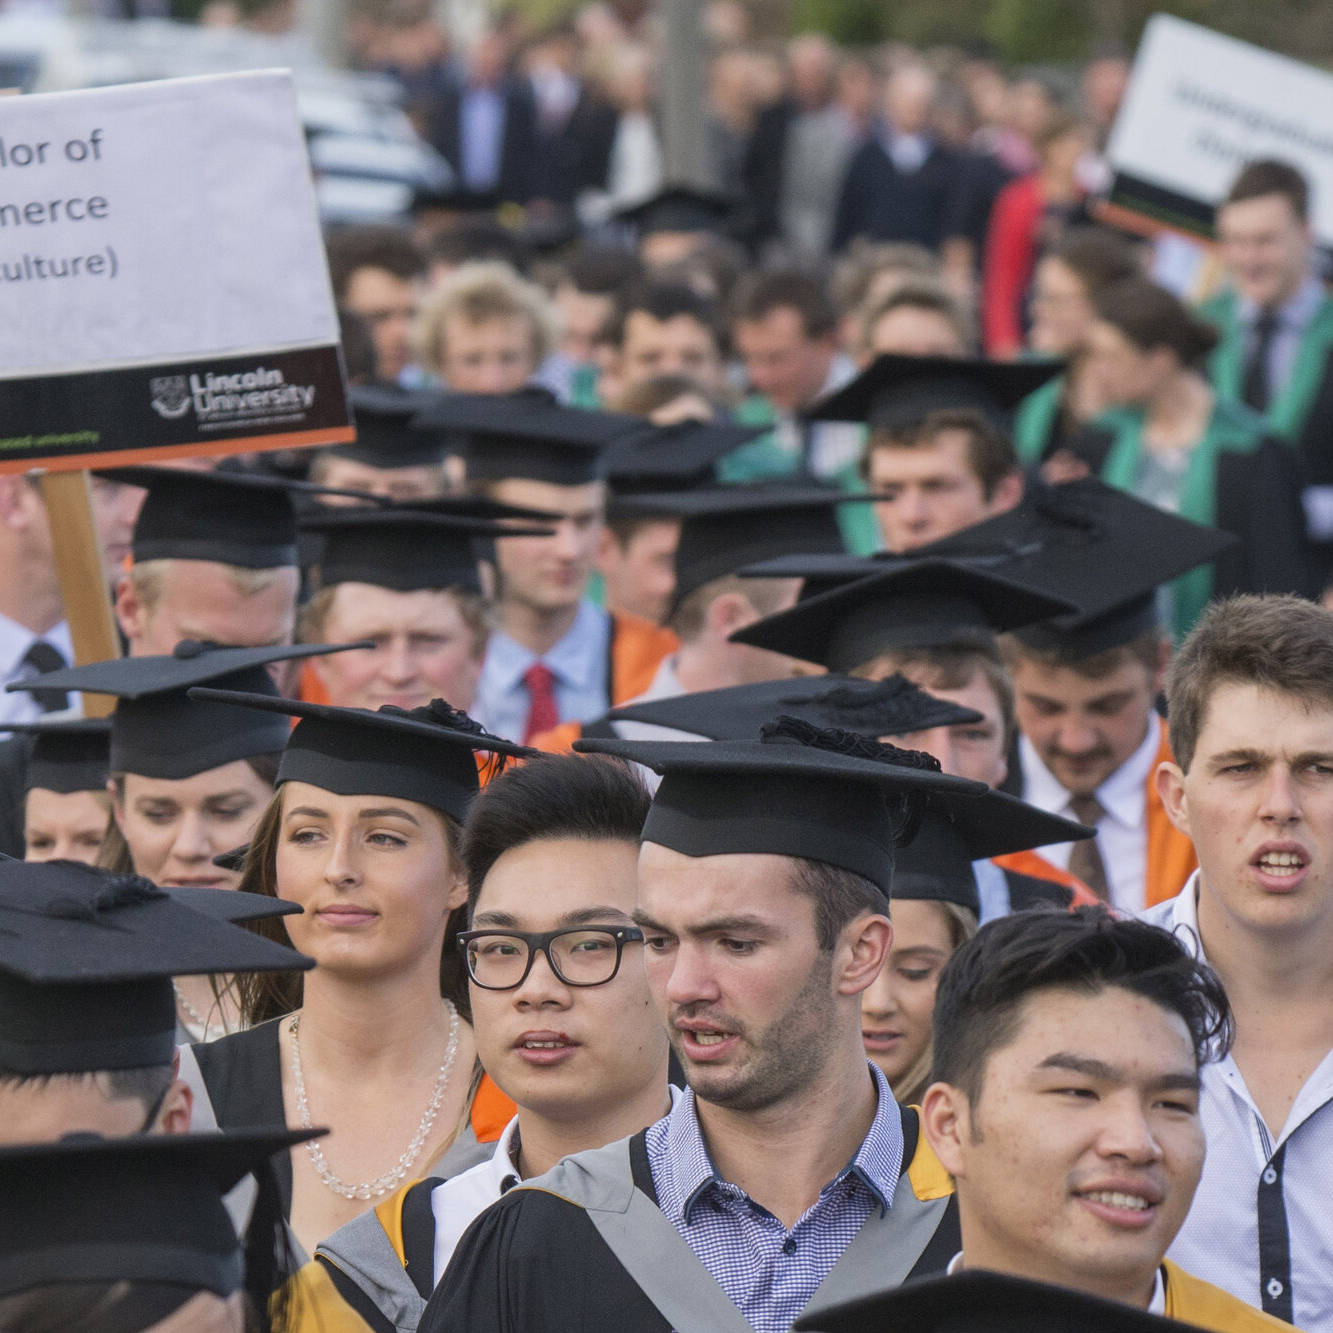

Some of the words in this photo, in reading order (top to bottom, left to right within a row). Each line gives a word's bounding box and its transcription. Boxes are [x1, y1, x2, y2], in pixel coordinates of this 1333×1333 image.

[63, 128, 103, 162] of
[189, 367, 284, 394] Lincoln
[193, 384, 316, 413] University
